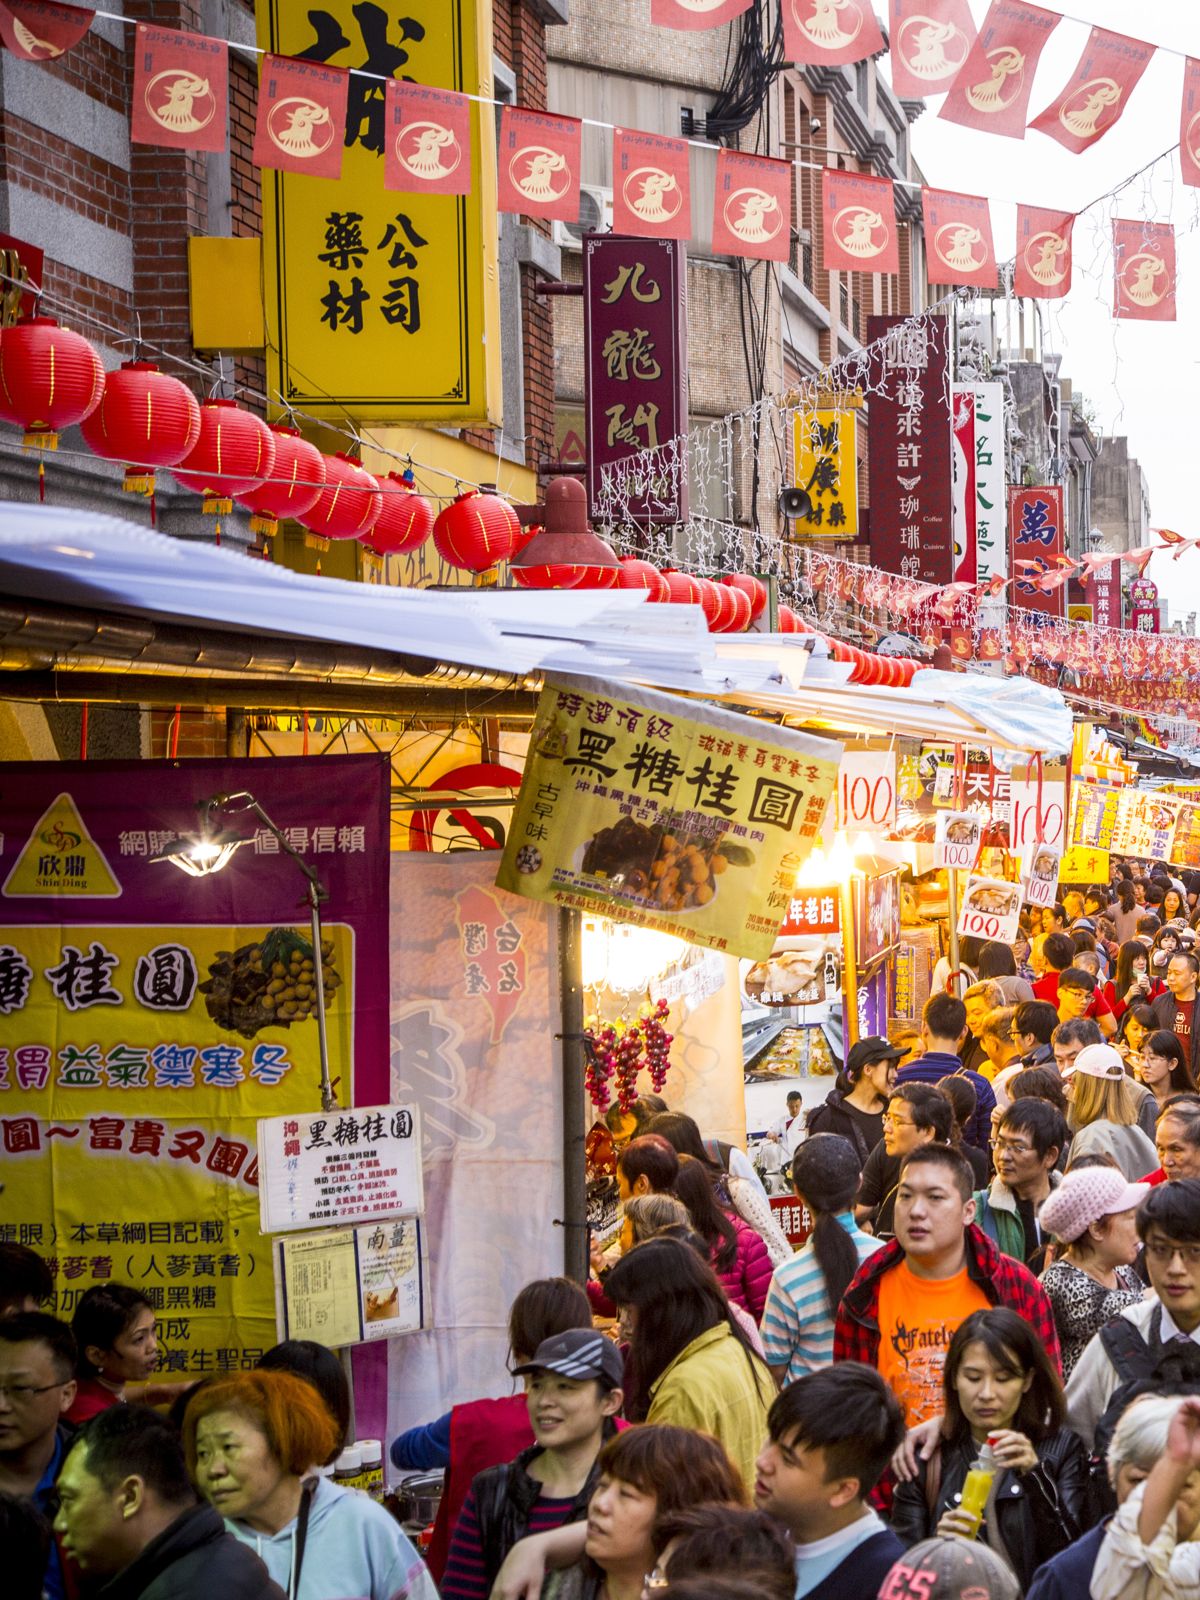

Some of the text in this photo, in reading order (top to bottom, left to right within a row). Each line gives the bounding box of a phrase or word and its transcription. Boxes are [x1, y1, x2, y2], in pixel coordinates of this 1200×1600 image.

[564, 727, 804, 833] 黑糖桂圓
[526, 782, 561, 842] 古早味
[843, 776, 893, 826] 100
[37, 856, 86, 877] 欣鼎
[944, 845, 969, 865] 100
[35, 877, 87, 889] Shin Ding
[1030, 880, 1050, 903] 100
[782, 895, 834, 927] 年老店
[283, 1120, 301, 1158] 沖繩
[305, 1109, 413, 1151] 黑糖桂圓
